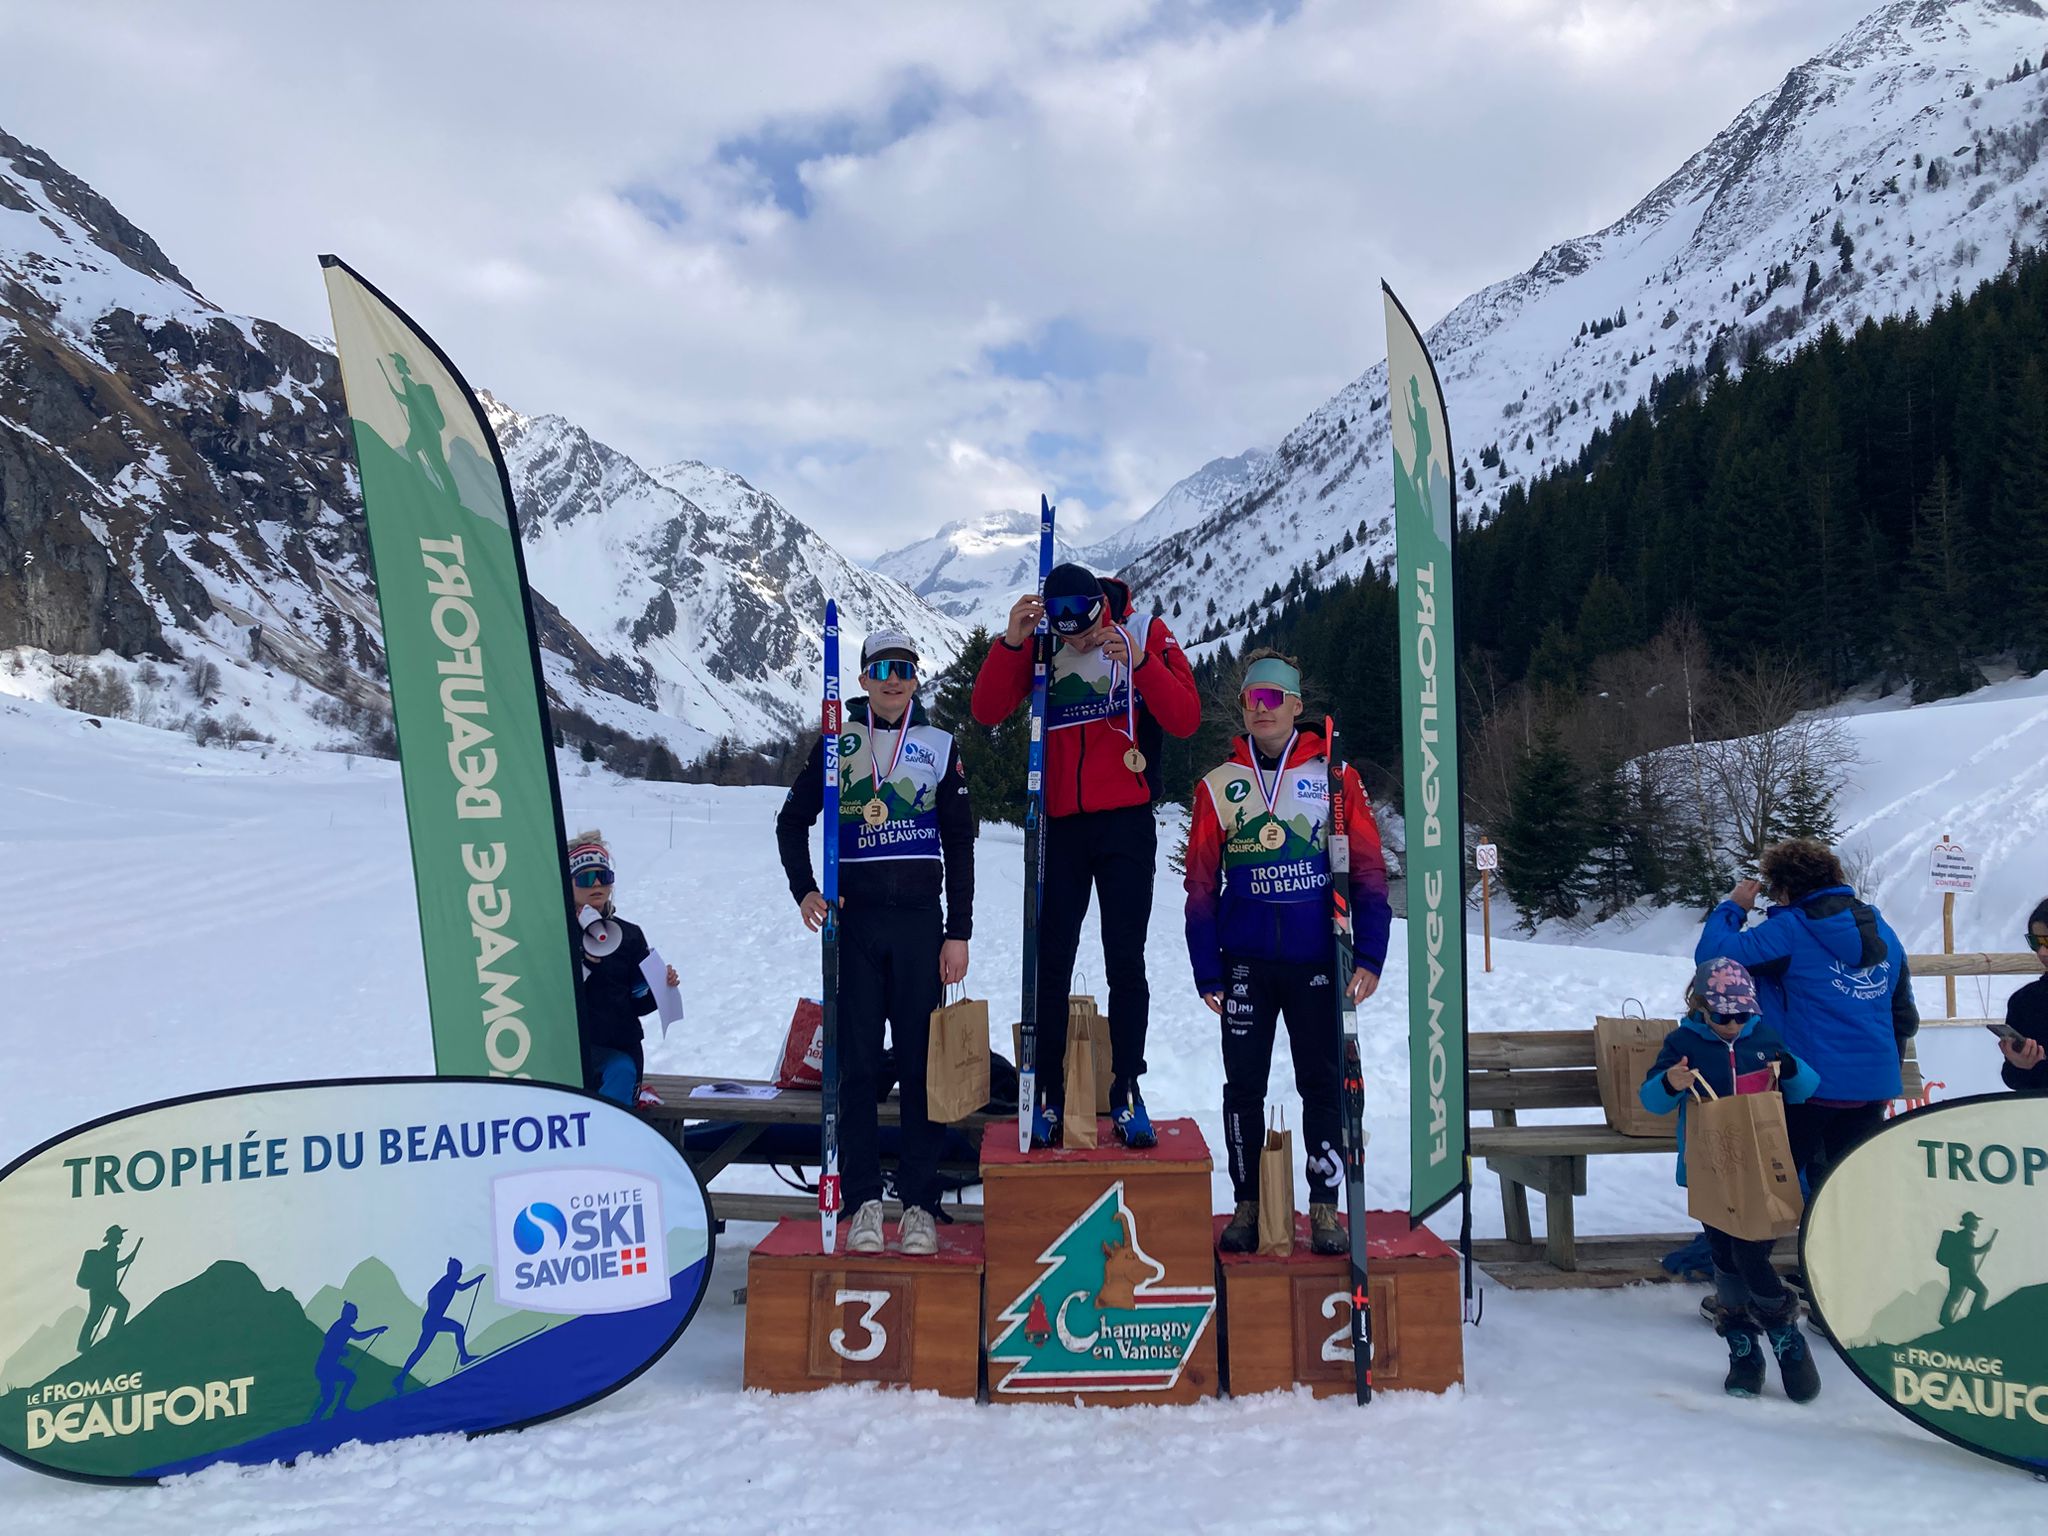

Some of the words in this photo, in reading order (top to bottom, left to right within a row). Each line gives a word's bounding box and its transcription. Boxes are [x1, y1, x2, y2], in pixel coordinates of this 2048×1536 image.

[827, 703, 837, 731] swix
[844, 735, 856, 754] 3
[1132, 753, 1138, 765] 1
[1230, 782, 1247, 801] 2
[870, 805, 881, 818] 3
[1333, 789, 1345, 836] SSIGNOL
[858, 836, 876, 849] DU
[1266, 829, 1278, 841] 2
[1250, 859, 1314, 881] TROPHÉE
[1250, 881, 1271, 895] DU
[1237, 1003, 1254, 1013] JMJ
[63, 1130, 289, 1199] TROPHÉE
[303, 1131, 364, 1173] DU
[379, 1111, 591, 1166] BEAUFORT
[1917, 1139, 2048, 1186] TROP
[570, 1188, 643, 1210] COMITE
[571, 1203, 646, 1252] SKI
[515, 1251, 619, 1290] SAVOIE
[829, 1289, 891, 1361] 3
[1056, 1291, 1192, 1353] Champagny
[1321, 1291, 1375, 1362] 2
[1092, 1347, 1113, 1360] en
[1116, 1338, 1183, 1360] Vanoise
[1893, 1352, 1908, 1364] LE
[1908, 1349, 2004, 1376] FROMAGE
[27, 1394, 41, 1406] LE
[43, 1372, 143, 1403] FROMAGE
[1894, 1367, 2048, 1425] BEAUFO
[27, 1376, 254, 1449] BEAUFORT
